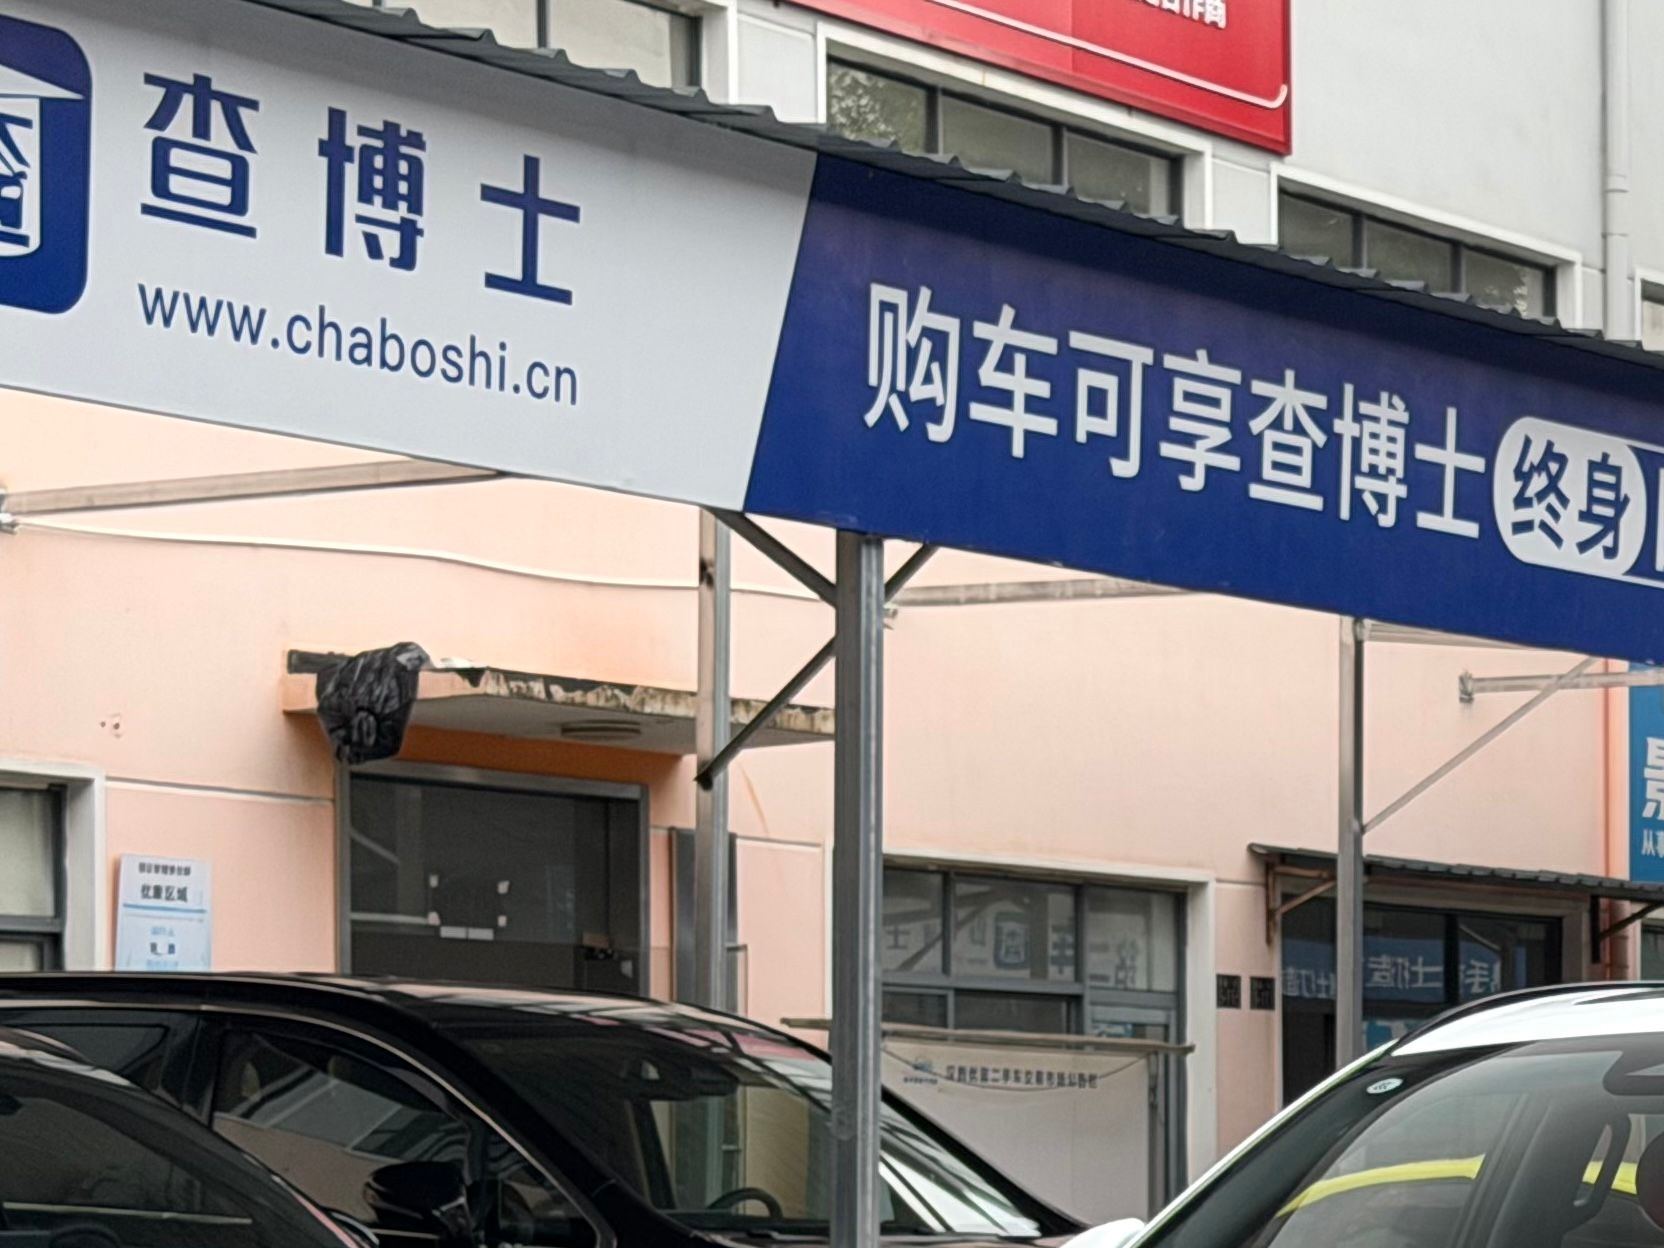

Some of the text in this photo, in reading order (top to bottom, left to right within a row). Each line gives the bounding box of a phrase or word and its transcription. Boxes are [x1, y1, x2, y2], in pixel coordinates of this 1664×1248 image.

[140, 72, 581, 306] 查博士
[137, 282, 579, 406] www.chaboshi.cn
